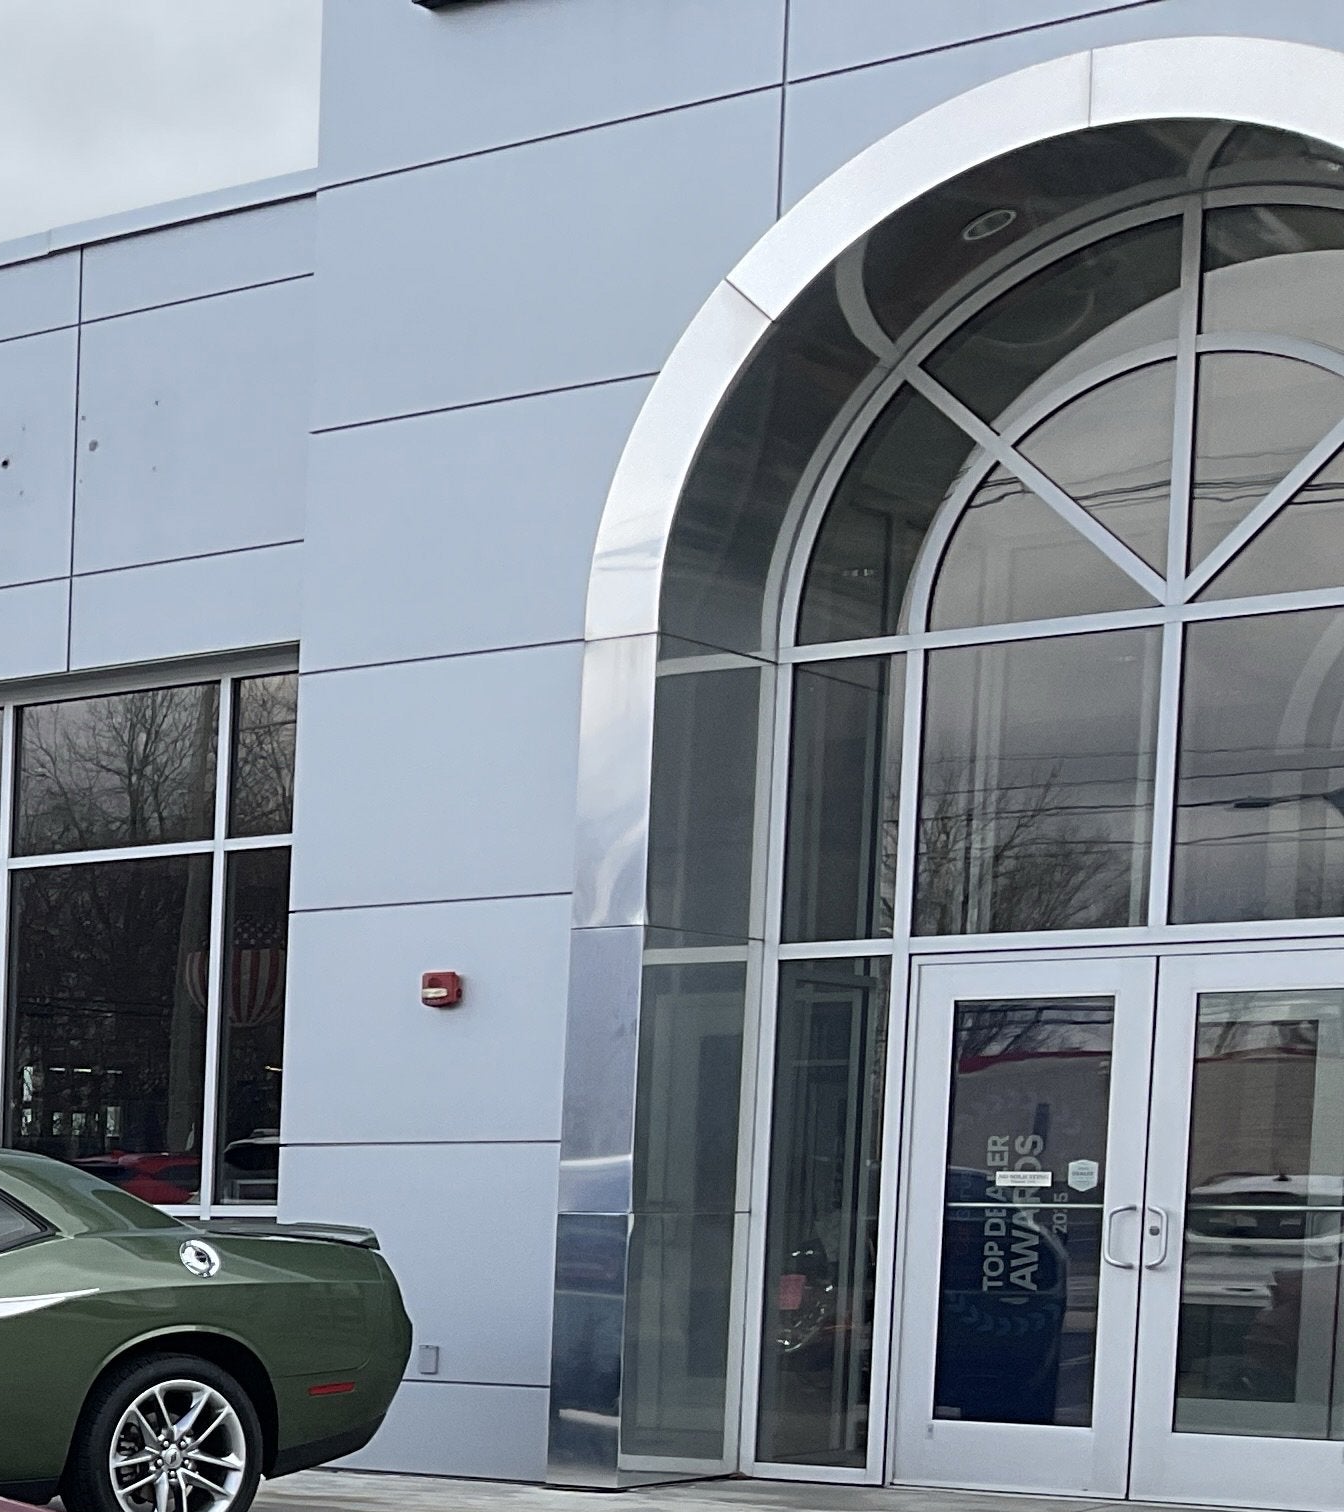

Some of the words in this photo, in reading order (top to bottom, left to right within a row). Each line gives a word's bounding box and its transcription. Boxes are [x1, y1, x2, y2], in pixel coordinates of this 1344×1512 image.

[1010, 1134, 1044, 1291] AWARDS
[1053, 1192, 1069, 1234] 205
[982, 1241, 1005, 1292] TOP
